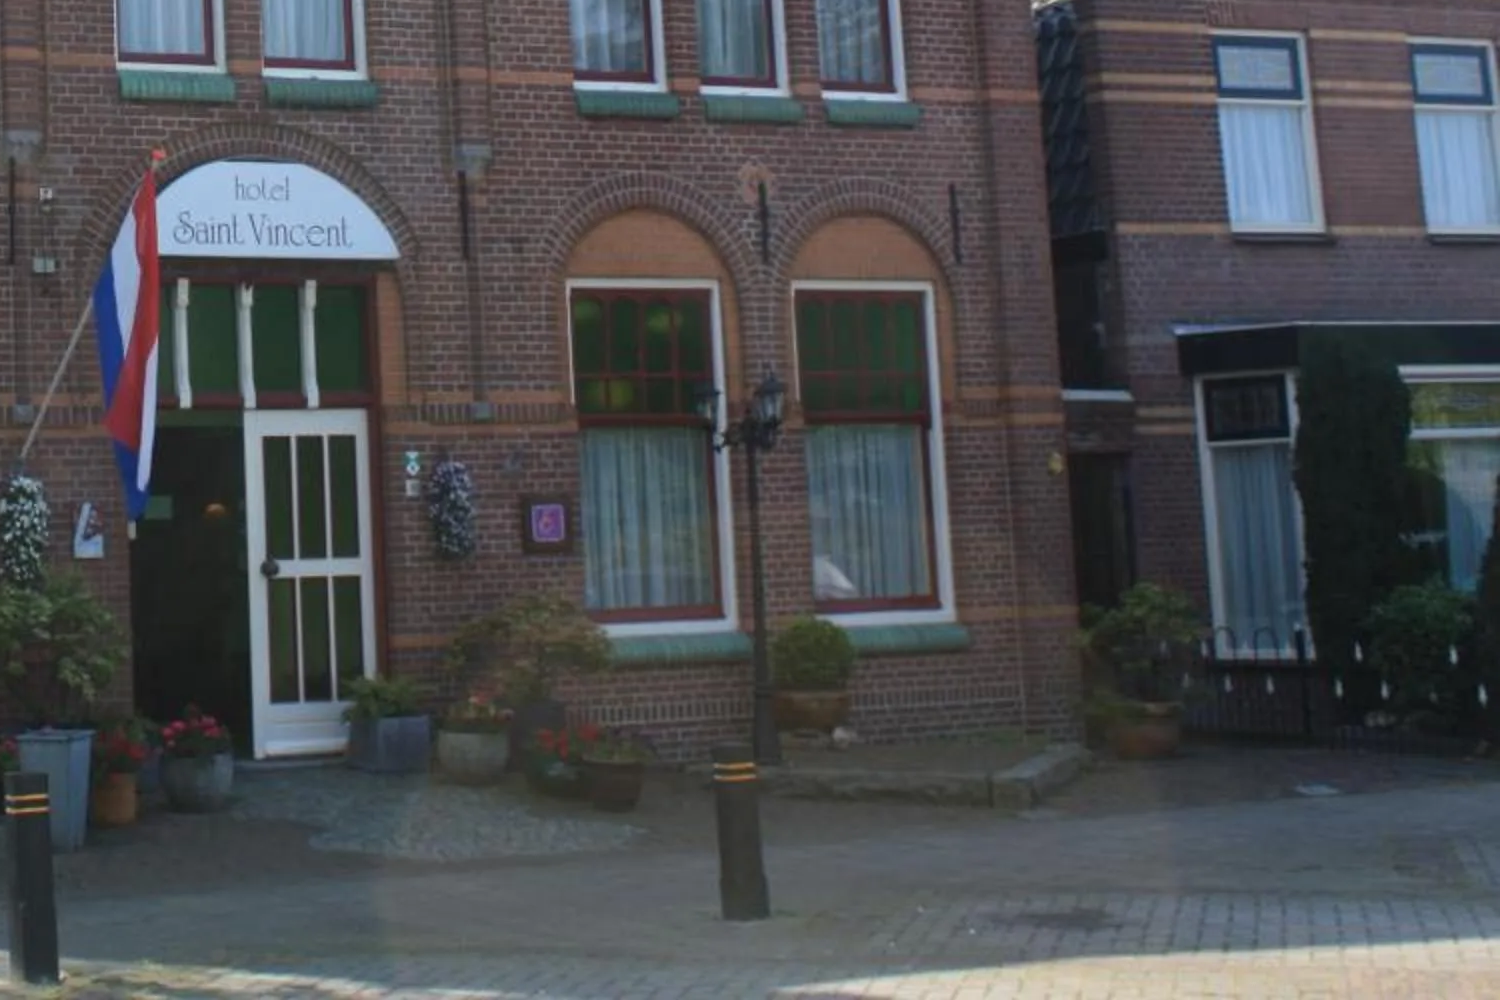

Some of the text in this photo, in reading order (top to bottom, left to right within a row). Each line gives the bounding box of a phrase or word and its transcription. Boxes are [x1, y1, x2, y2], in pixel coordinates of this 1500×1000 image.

[235, 176, 290, 201] hotel
[173, 210, 353, 249] Saint Vincent
